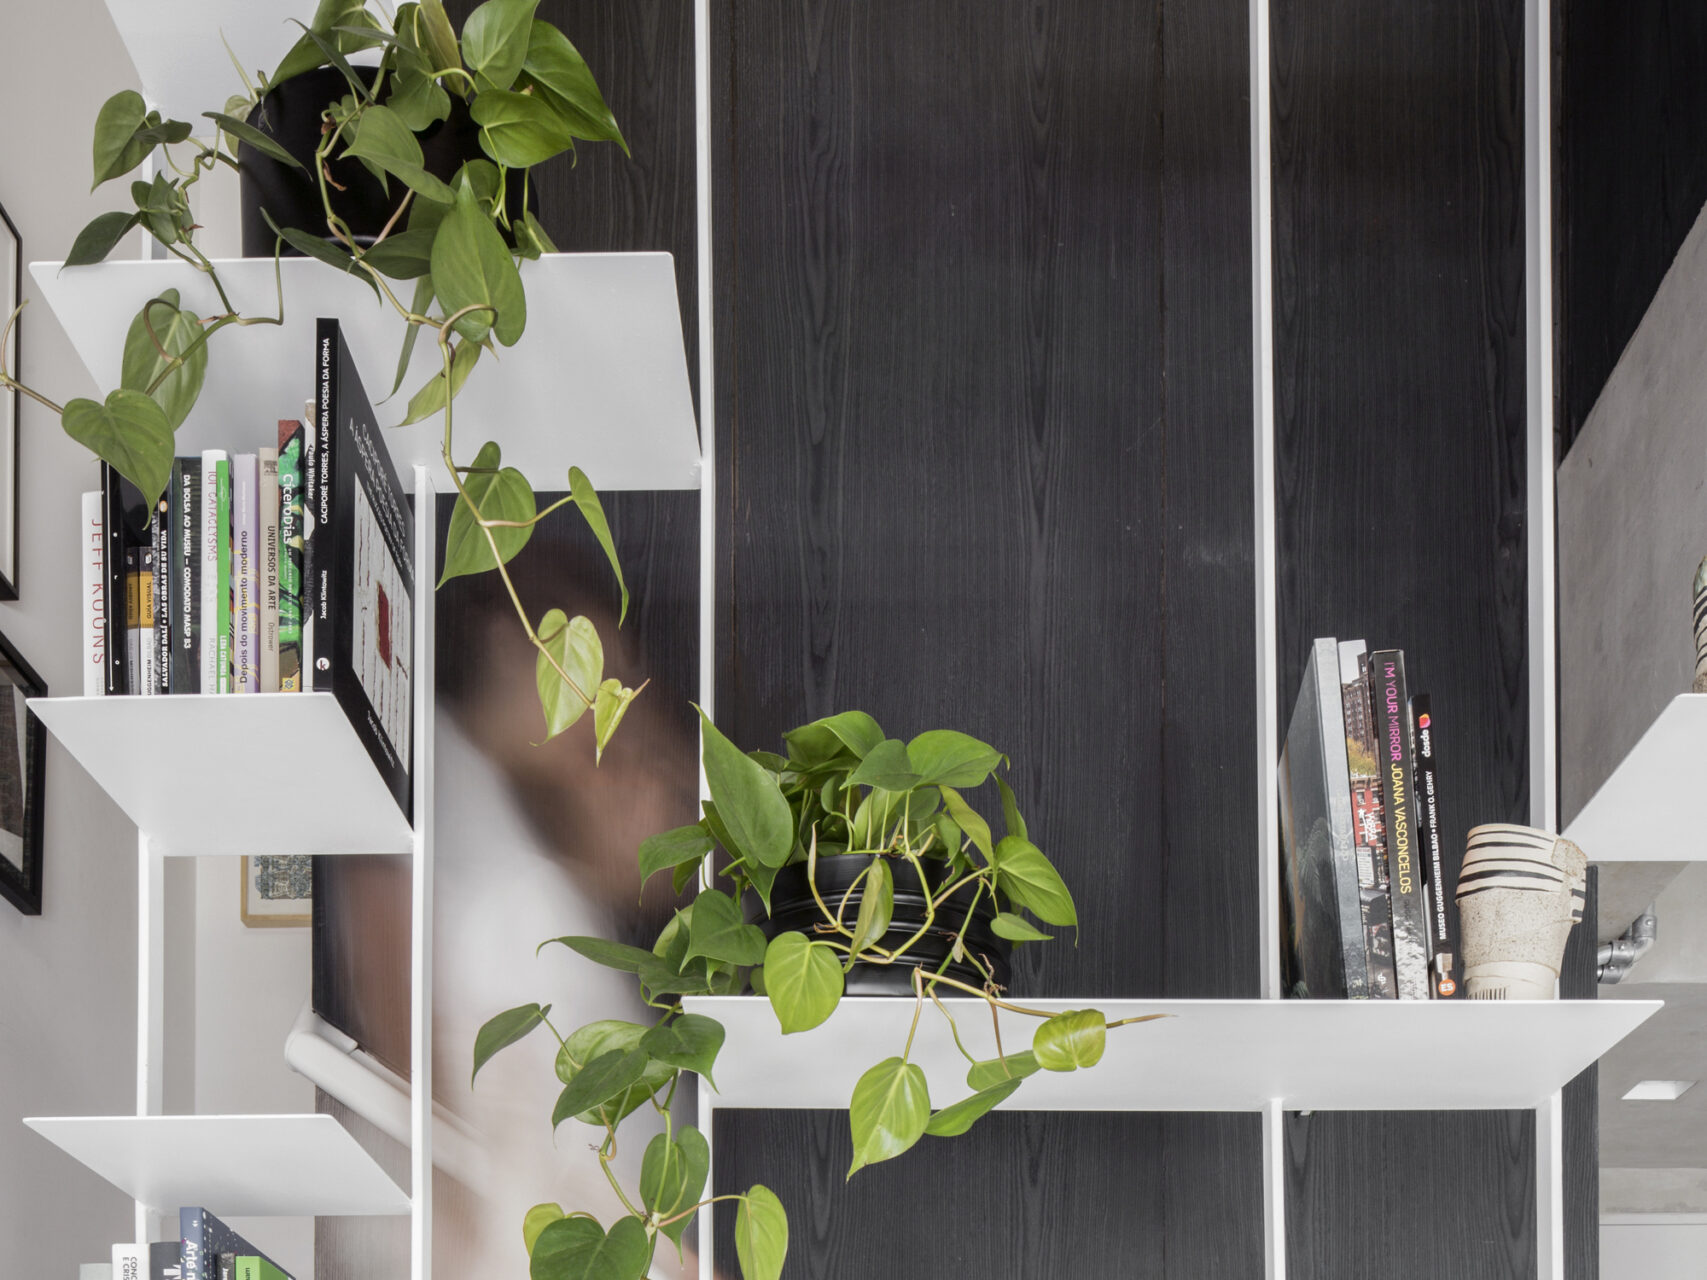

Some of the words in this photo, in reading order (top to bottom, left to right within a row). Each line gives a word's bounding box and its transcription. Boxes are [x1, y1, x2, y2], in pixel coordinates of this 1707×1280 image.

[322, 338, 330, 366] FORMA
[322, 368, 330, 379] DA
[322, 383, 330, 409] POESIA
[320, 412, 329, 441] ÁSPERA
[183, 475, 191, 486] DA
[321, 451, 330, 483] TORRES,
[183, 488, 191, 513] BOLSA
[318, 485, 328, 524] CACIPORÉ
[184, 515, 191, 527] AO
[161, 549, 167, 561] SU
[240, 531, 248, 575] moderno
[267, 526, 276, 572] UNIVERSOS
[161, 563, 167, 573] DE
[268, 575, 276, 587] DA
[240, 578, 248, 632] movimento
[268, 589, 276, 610] ARTE
[320, 602, 328, 619] Jacob
[160, 625, 168, 644] DALÍ
[184, 638, 191, 648] B3
[240, 634, 248, 647] do
[240, 648, 249, 683] Depois
[1384, 662, 1396, 678] I'M
[1385, 680, 1399, 713] YOUR
[1388, 716, 1402, 761] MIRROR
[1421, 729, 1431, 757] dosde
[1390, 763, 1406, 805] JOANA
[1425, 770, 1434, 795] GEHRY
[1428, 804, 1437, 828] FRANK
[1395, 807, 1412, 894] VASCONCELOS
[1430, 834, 1440, 861] BILBAO
[1432, 862, 1445, 912] GUGGENHEIM
[1437, 913, 1447, 940] MUSEO
[185, 1240, 198, 1269] Arte
